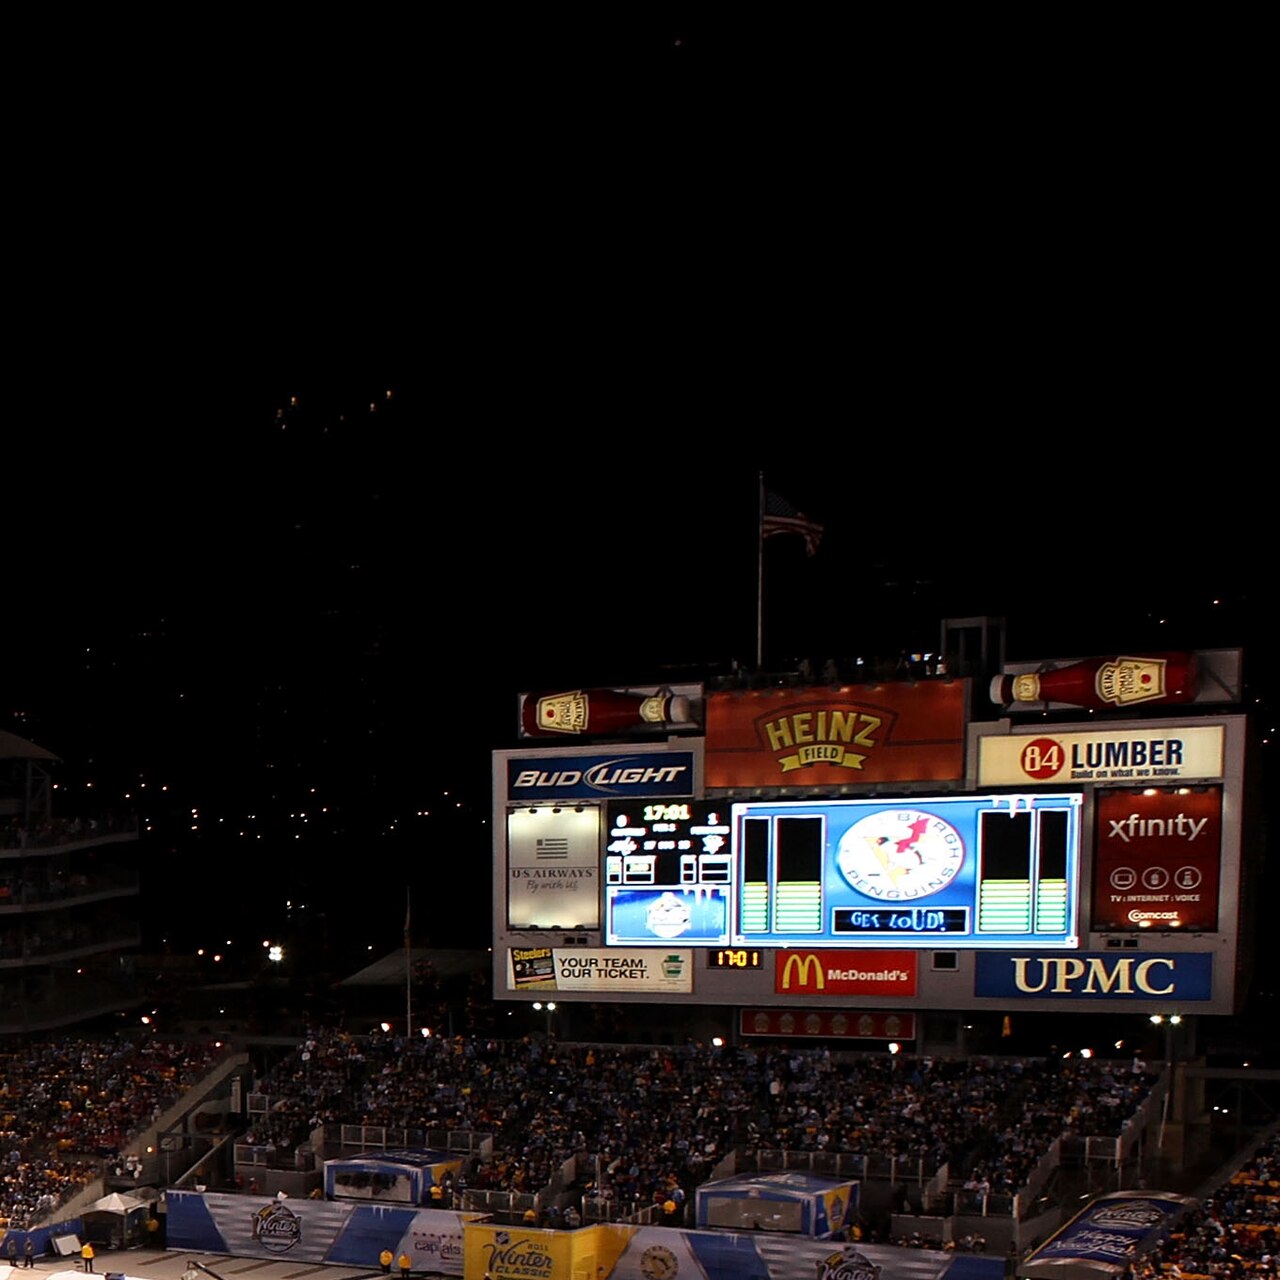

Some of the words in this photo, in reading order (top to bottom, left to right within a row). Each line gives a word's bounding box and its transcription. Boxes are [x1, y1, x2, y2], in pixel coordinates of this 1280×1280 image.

[1104, 664, 1115, 695] HEINZ
[765, 711, 881, 750] HEINZ
[805, 747, 838, 760] FIELD
[1024, 745, 1059, 771] 84
[1072, 740, 1182, 768] LUMBER
[514, 771, 583, 787] BUD
[593, 766, 686, 785] LIGHT
[1071, 770, 1093, 778] Build
[1096, 770, 1108, 778] on
[1110, 768, 1133, 777] what
[1137, 768, 1151, 776] we
[643, 804, 690, 820] 17:01
[1108, 813, 1208, 842] xfinity
[533, 869, 592, 878] AIRWAYS
[526, 880, 539, 893] Fly
[542, 879, 563, 890] with
[847, 867, 954, 898] PENGUINS
[1175, 894, 1200, 902] VOICE
[851, 911, 879, 928] GET
[889, 909, 946, 931] LOUD!
[513, 948, 552, 961] Steelers
[717, 951, 759, 967] 17:01
[559, 957, 599, 968] YOUR
[603, 958, 648, 969] TEAM.
[561, 968, 591, 978] OUR
[596, 968, 650, 979] TICKET.
[828, 969, 908, 982] McDonald's
[1011, 957, 1175, 994] UPMC
[482, 1239, 552, 1273] Winter
[495, 1266, 552, 1279] CLASSIC
